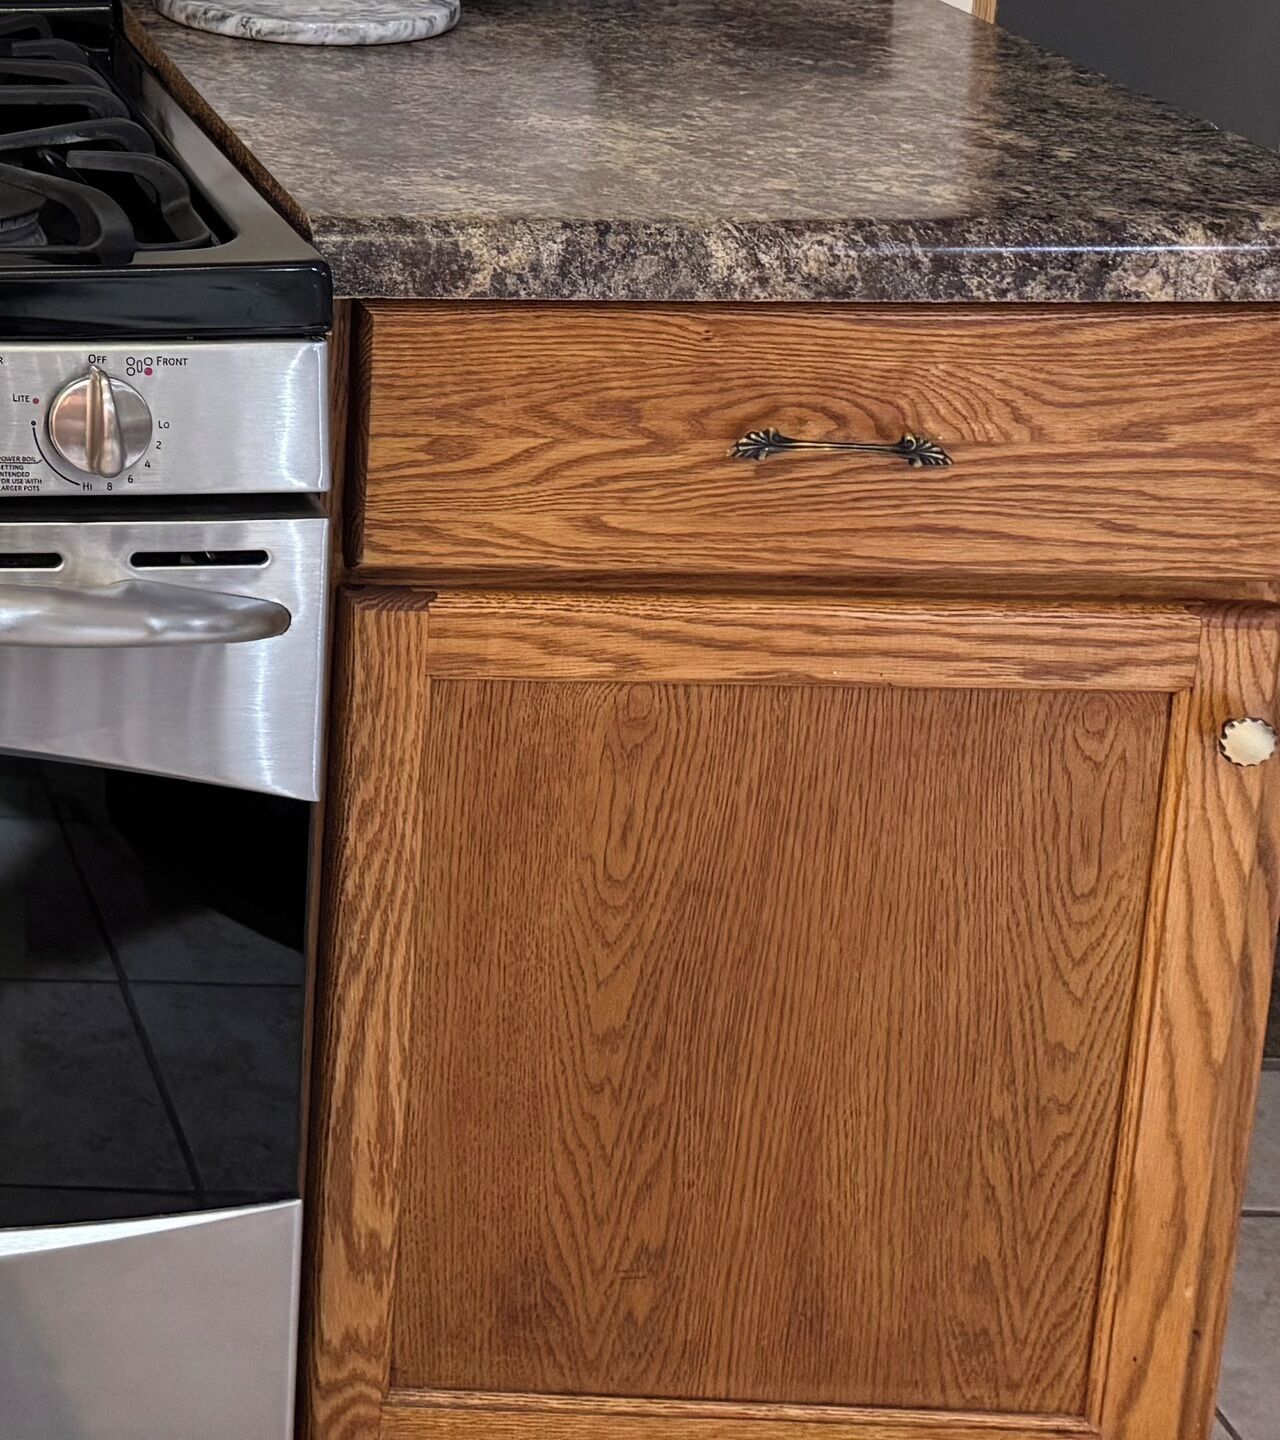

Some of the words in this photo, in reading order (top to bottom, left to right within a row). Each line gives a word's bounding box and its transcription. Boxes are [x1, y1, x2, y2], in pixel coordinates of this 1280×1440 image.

[88, 354, 107, 364] OFF
[157, 356, 188, 366] FRONT
[12, 394, 30, 402] LITE
[156, 441, 162, 449] 2
[145, 460, 151, 468] 4
[128, 475, 133, 483] 6
[107, 483, 113, 491] 8
